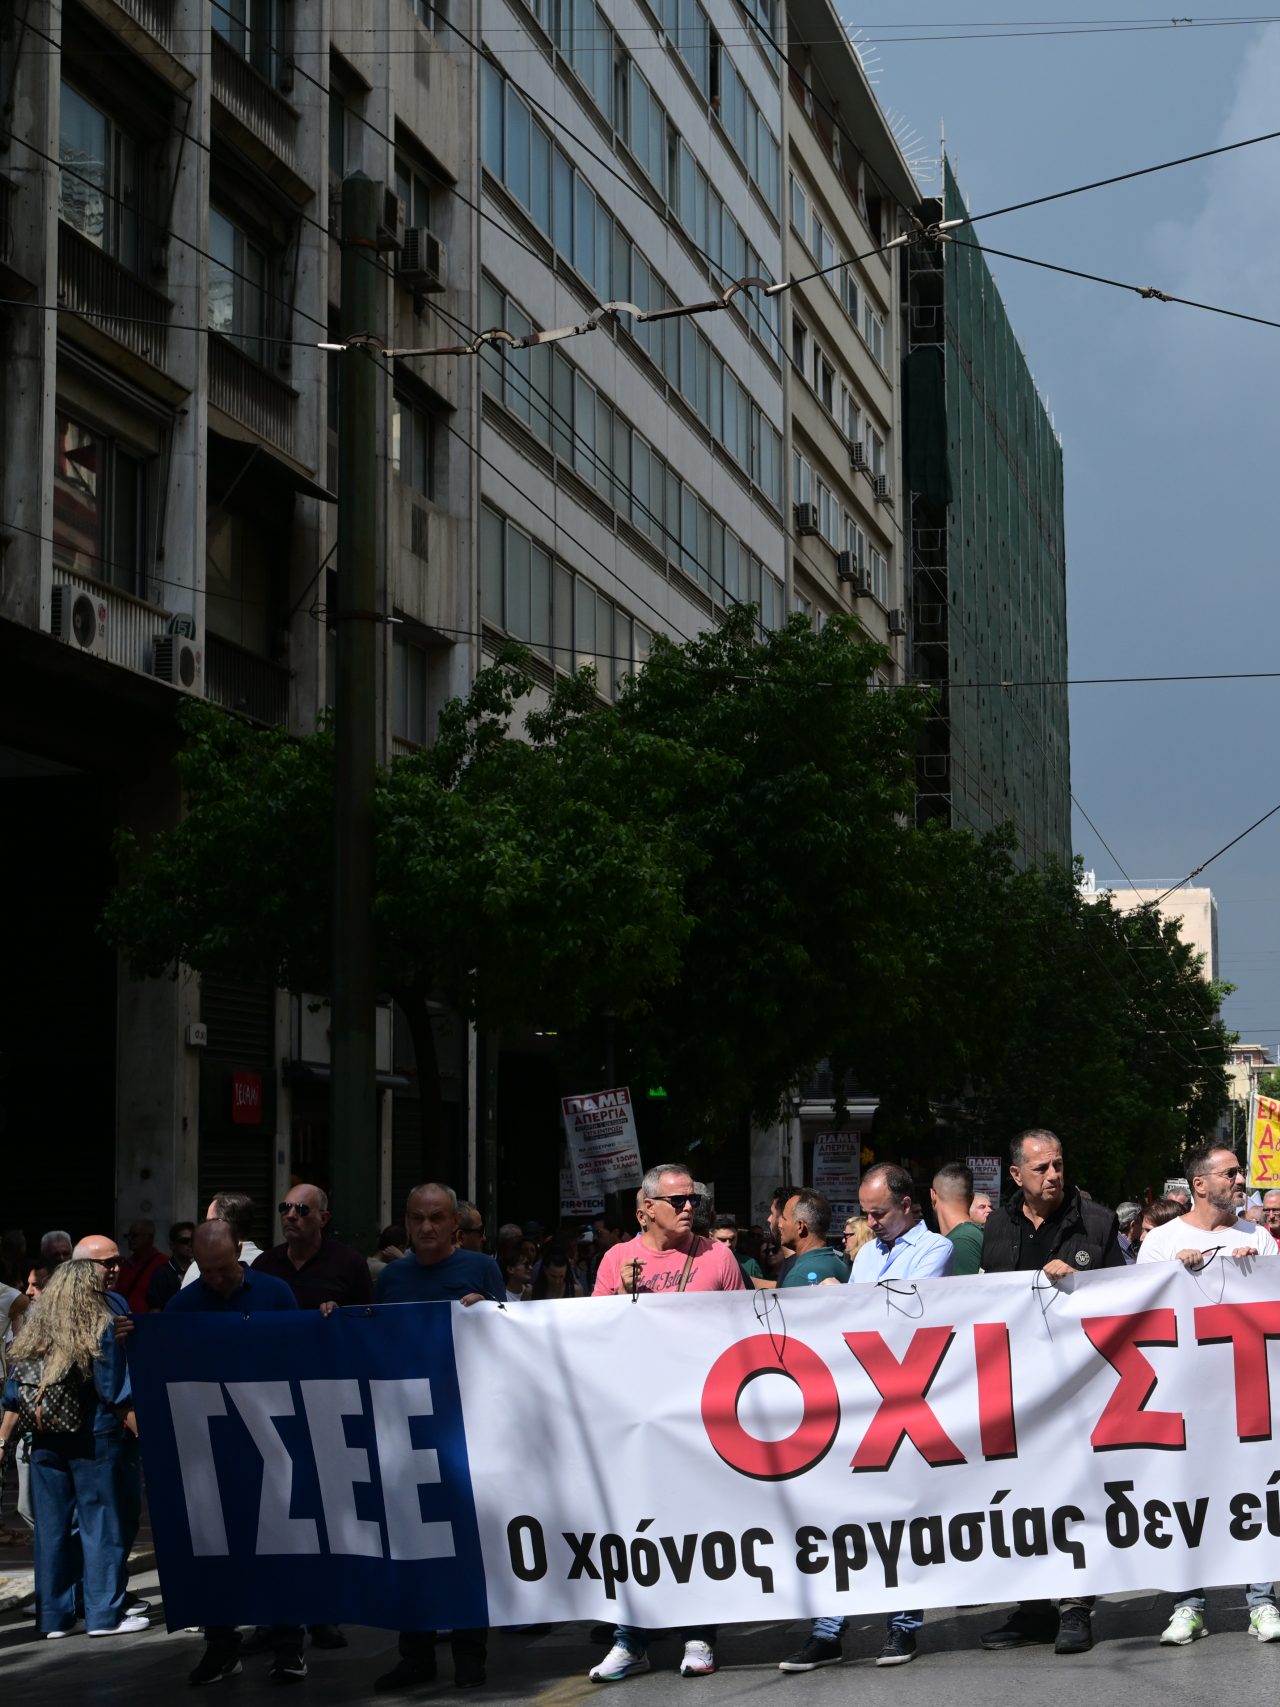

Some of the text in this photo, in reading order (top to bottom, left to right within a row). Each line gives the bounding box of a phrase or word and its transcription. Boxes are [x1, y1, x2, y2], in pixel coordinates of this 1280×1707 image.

[567, 1091, 627, 1113] ΠΑΜΕ
[575, 1107, 627, 1126] ΑΠΕΡΓΙΑ
[817, 1134, 858, 1143] ΠΑΜΕ
[968, 1158, 999, 1166] ΠΑΜΕ
[701, 1321, 1019, 1482] ΟΧΙ
[166, 1378, 457, 1561] ΓΣΕΕ
[507, 1515, 548, 1583] Ο
[562, 1519, 774, 1600] χρόνος
[795, 1490, 1086, 1593] εργασίας
[1105, 1481, 1210, 1550] δεν
